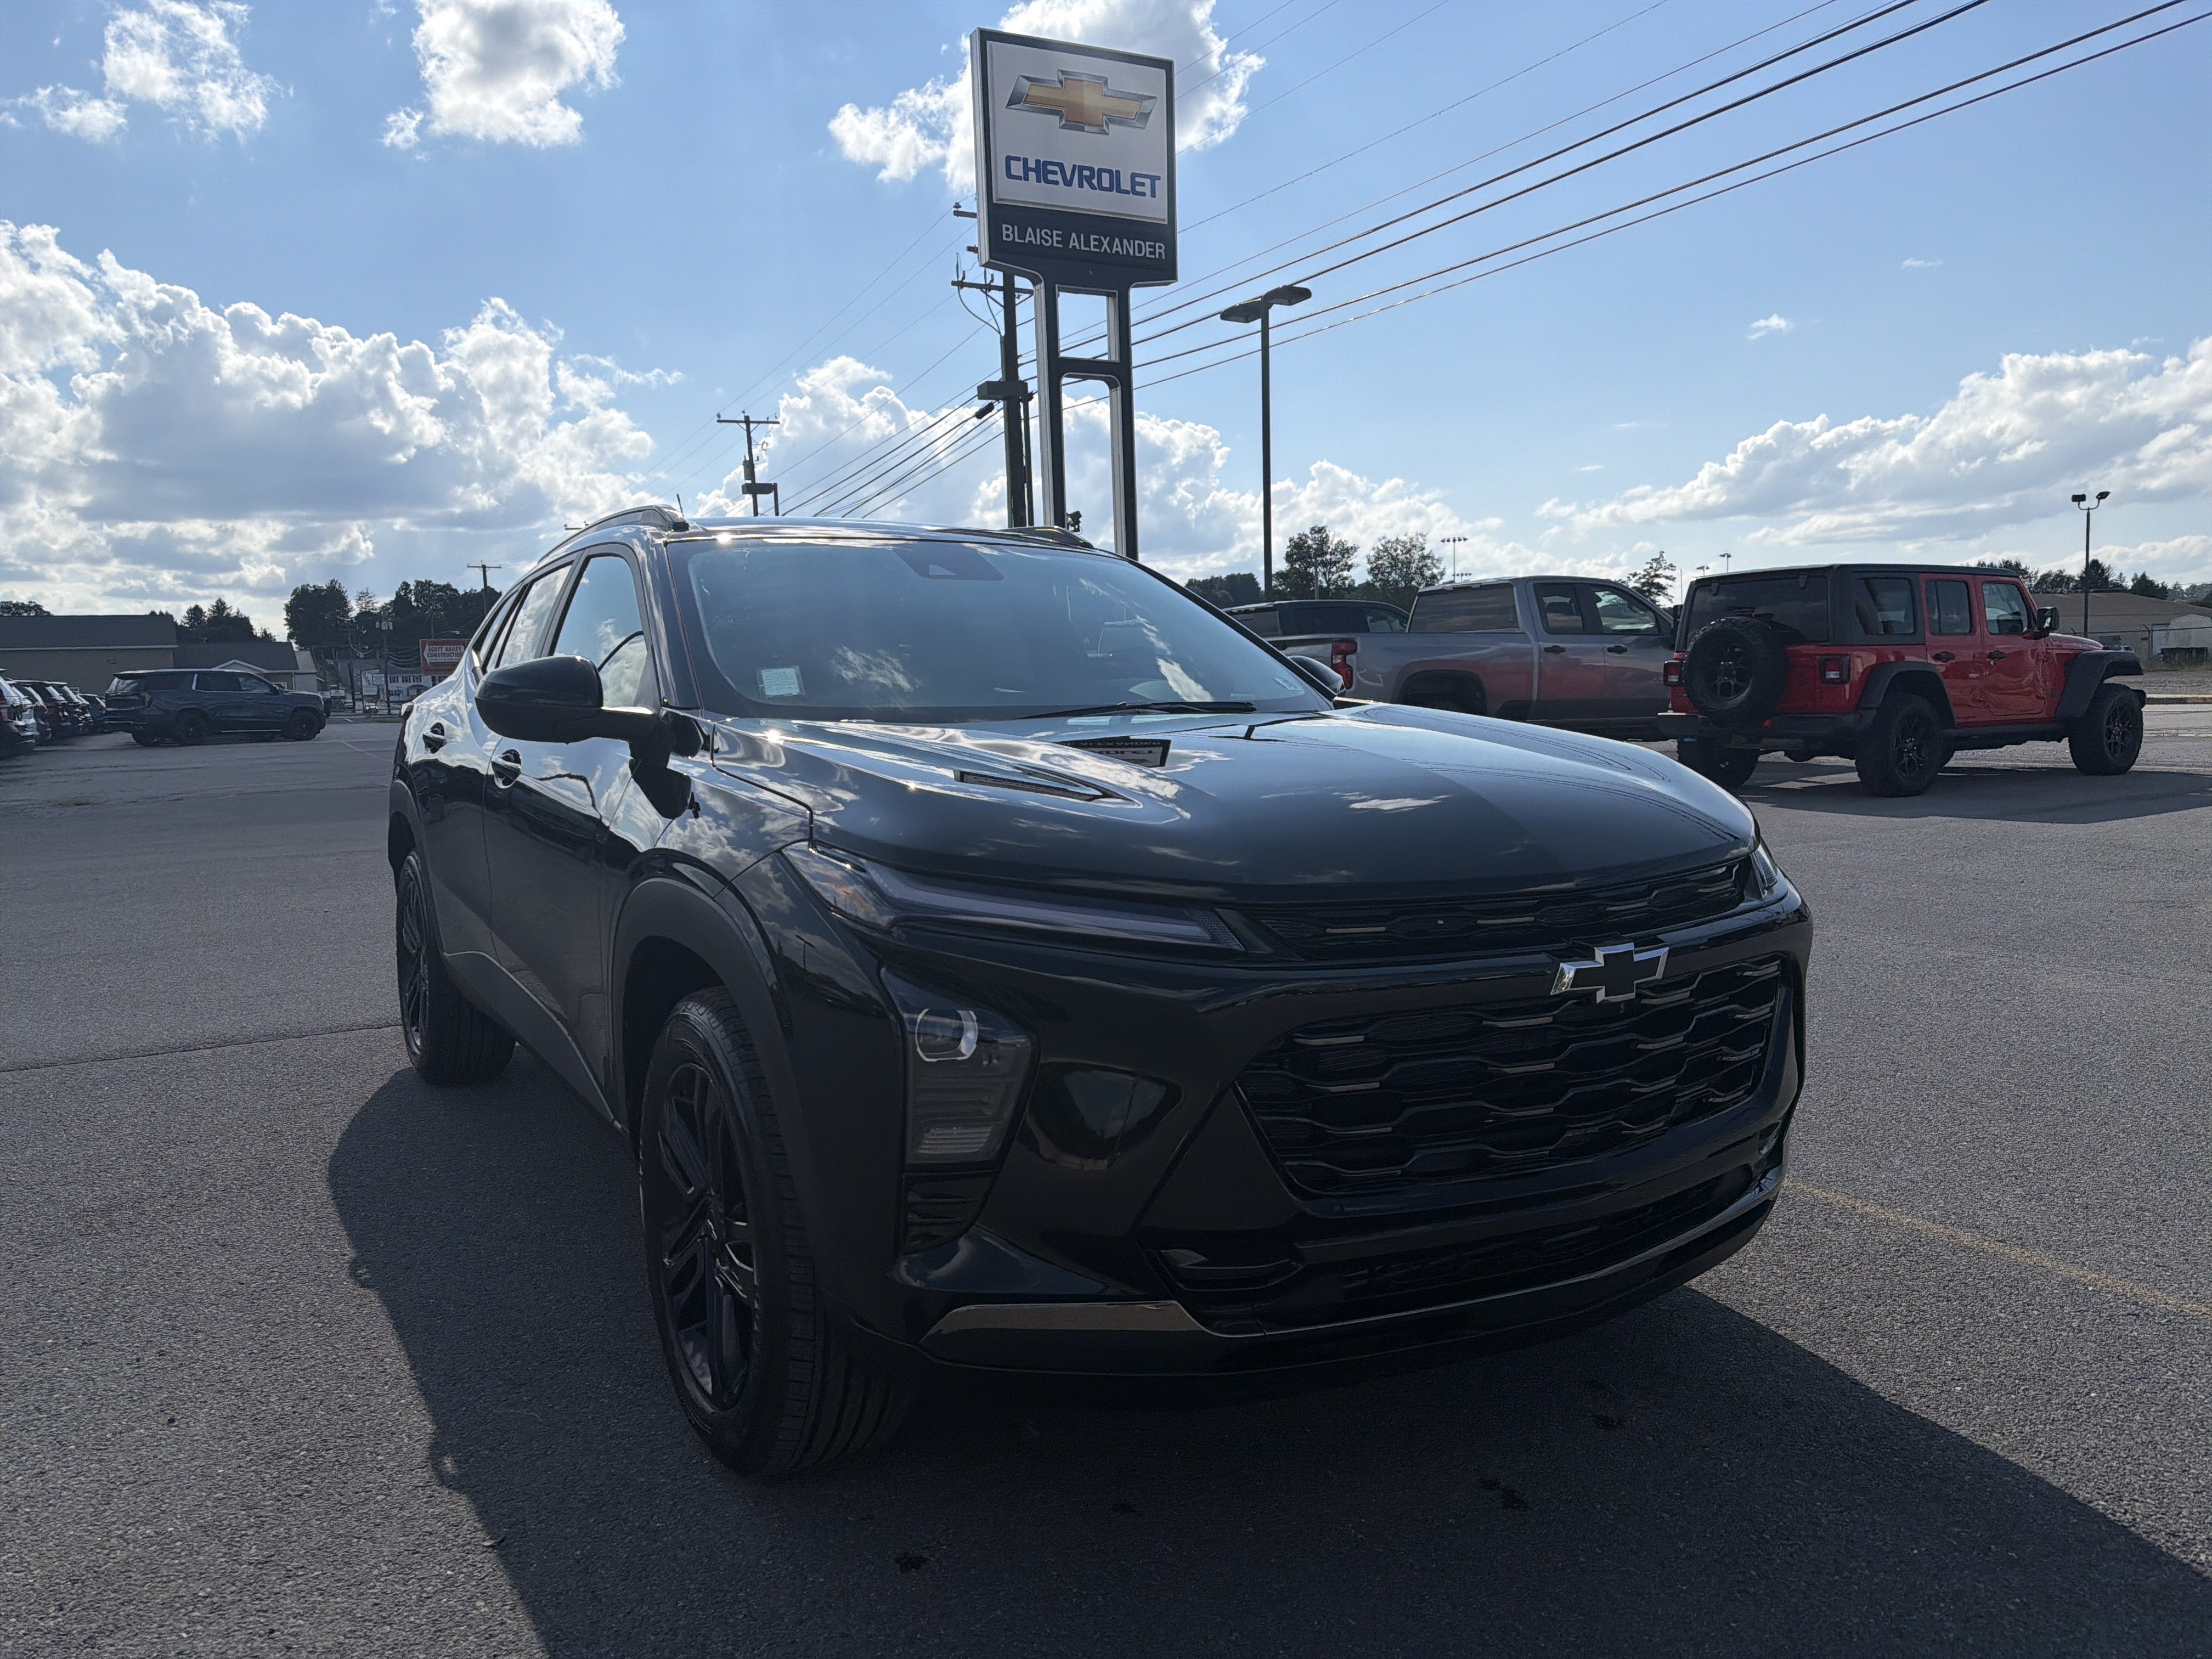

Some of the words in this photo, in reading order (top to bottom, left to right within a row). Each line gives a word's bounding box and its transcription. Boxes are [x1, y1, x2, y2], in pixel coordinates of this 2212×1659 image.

[1005, 155, 1161, 198] CHEVROLET
[1002, 223, 1063, 248] BLAISE
[1069, 232, 1166, 259] ALEXANDER
